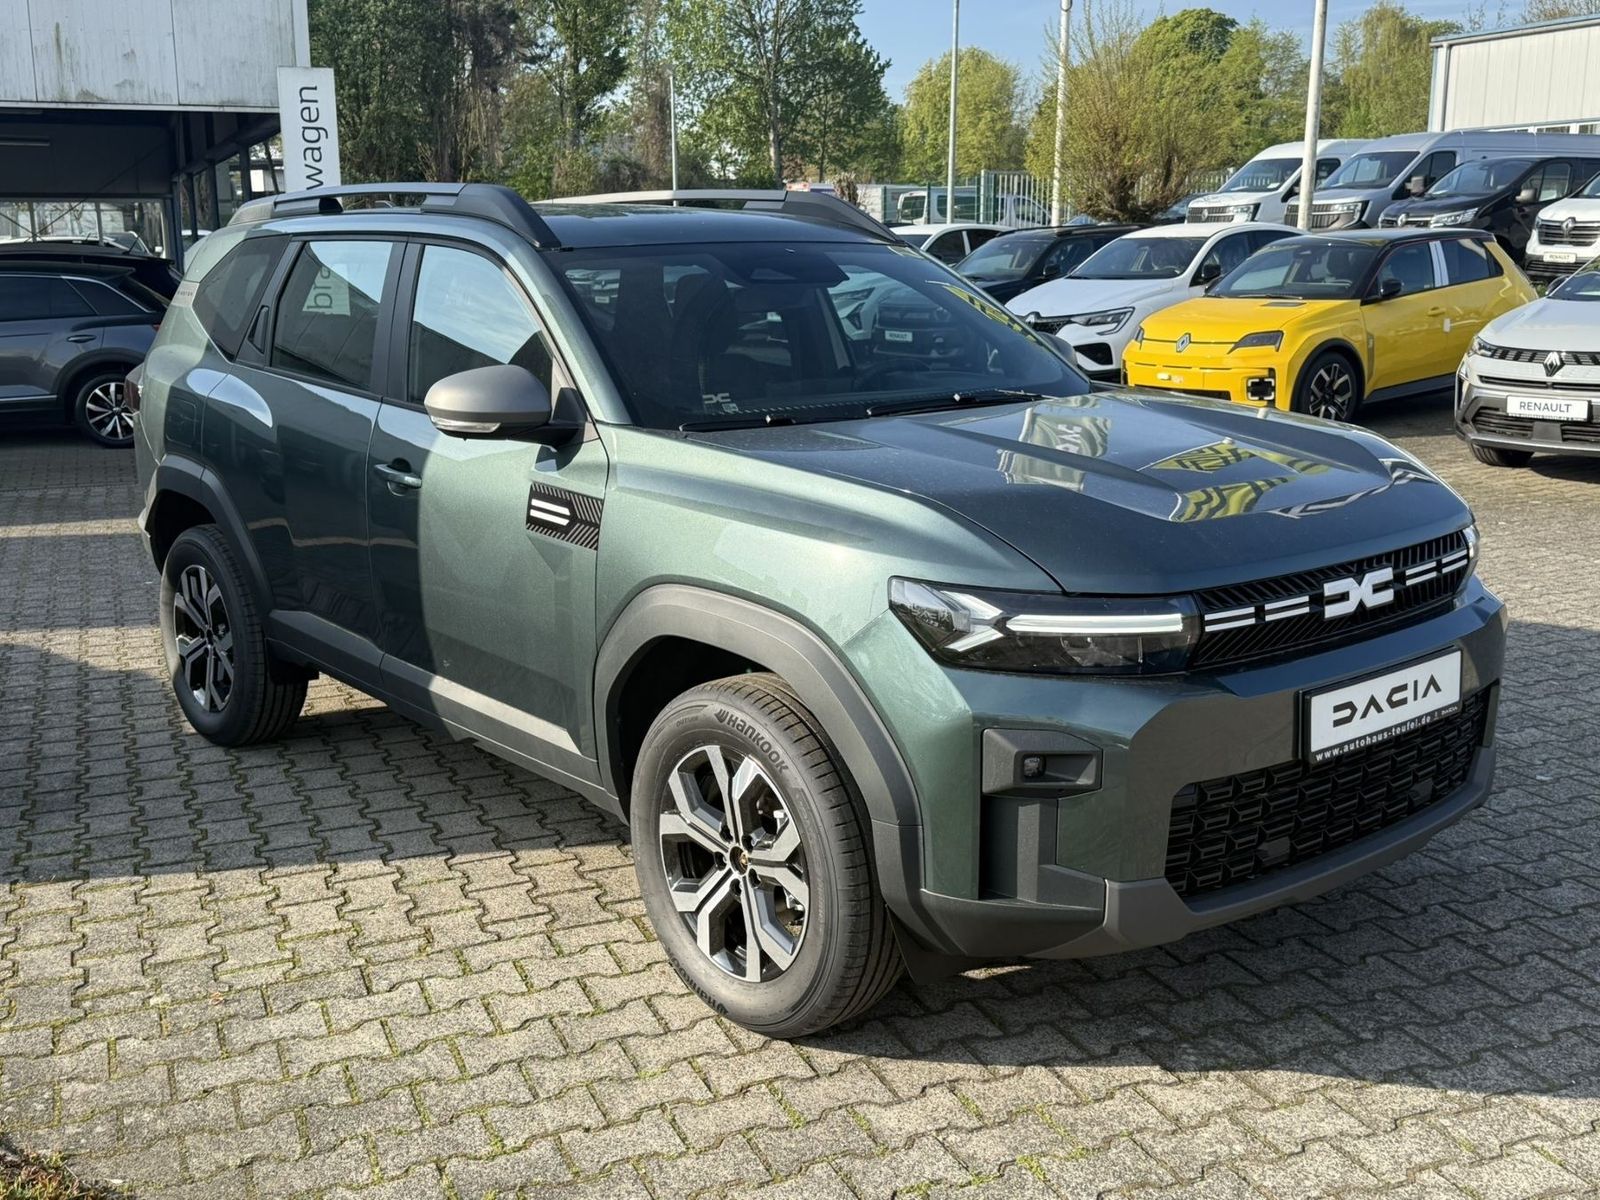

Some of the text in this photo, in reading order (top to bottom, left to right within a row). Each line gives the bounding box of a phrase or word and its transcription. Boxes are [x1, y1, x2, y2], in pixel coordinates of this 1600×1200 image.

[299, 85, 328, 191] wagen
[1519, 401, 1572, 413] RENAULT
[1332, 673, 1442, 728] DACIA
[1315, 714, 1431, 762] www.autohaus-teufel.de
